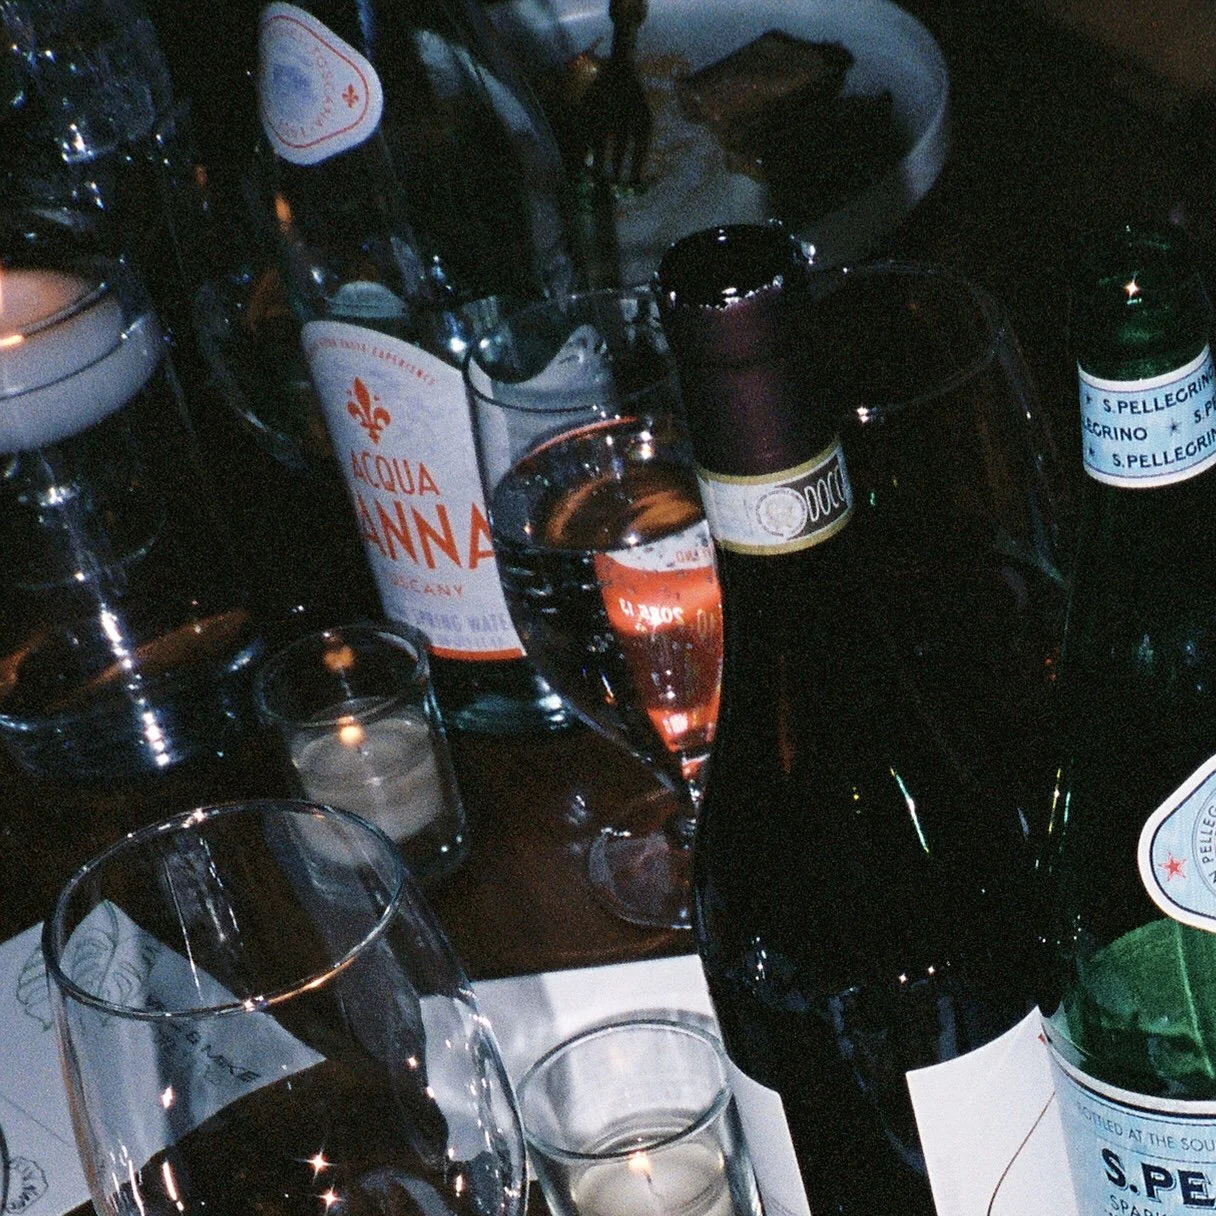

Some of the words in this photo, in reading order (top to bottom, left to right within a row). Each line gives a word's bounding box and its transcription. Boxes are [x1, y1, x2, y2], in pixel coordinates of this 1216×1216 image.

[1104, 366, 1215, 414] S.PELLEGRINO
[1083, 418, 1147, 441] LEGRINO
[351, 450, 440, 496] ACQUA
[356, 491, 496, 570] ANNA
[1078, 1102, 1123, 1136] OTTLED
[1129, 1129, 1143, 1143] AT
[1150, 1133, 1177, 1149] THE
